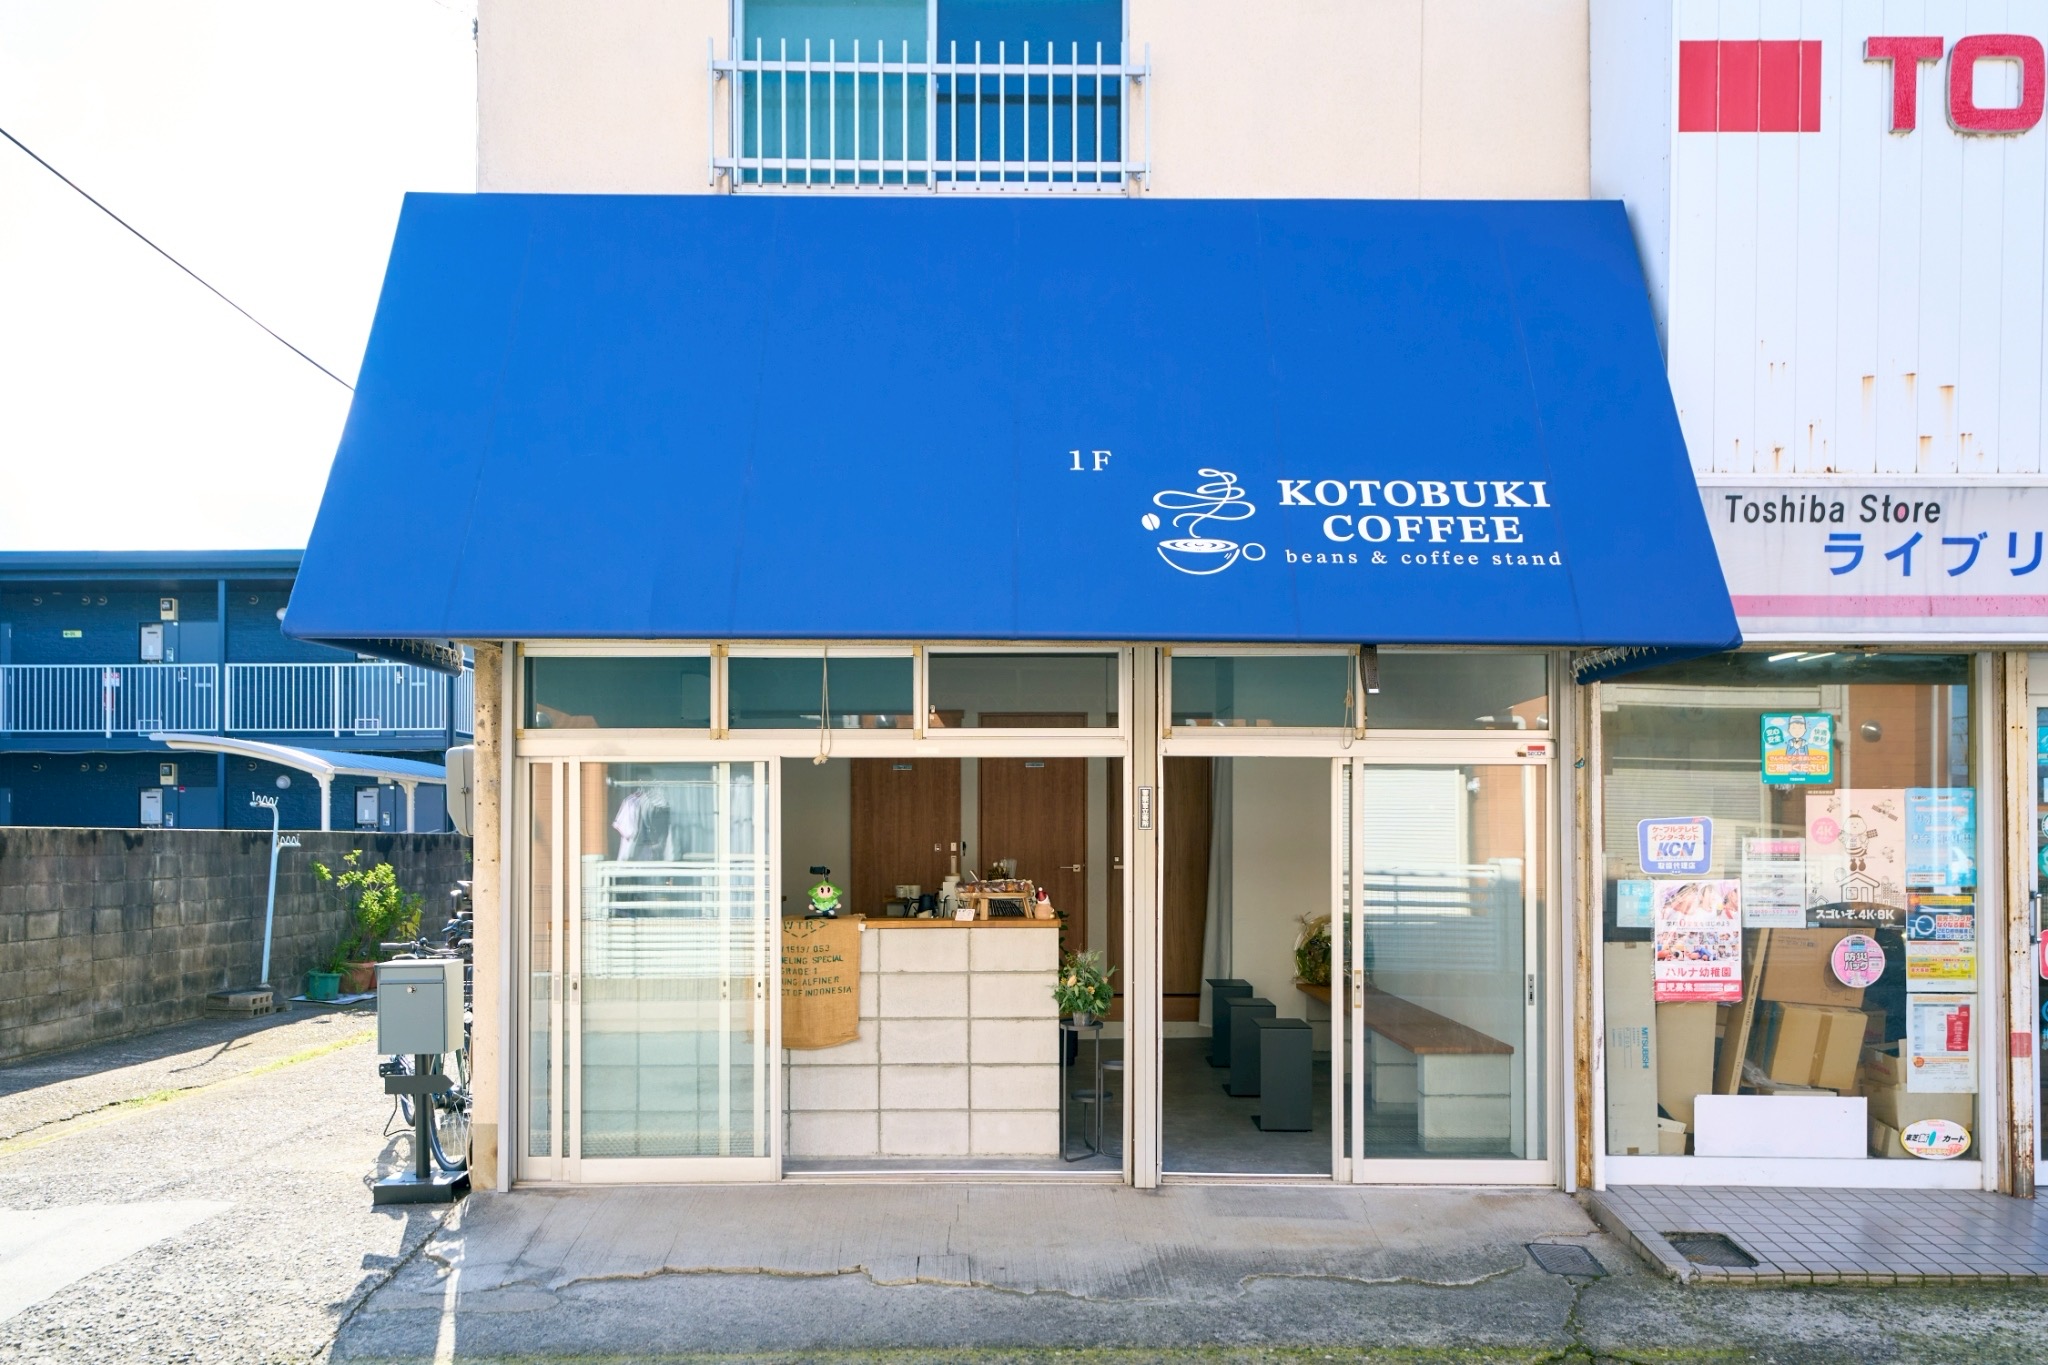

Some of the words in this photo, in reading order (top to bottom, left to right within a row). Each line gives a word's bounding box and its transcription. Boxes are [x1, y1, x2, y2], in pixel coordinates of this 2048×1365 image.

[1863, 34, 2046, 135] TO
[1069, 449, 1112, 471] 1F
[1276, 479, 1551, 508] KOTOBUKI
[1725, 494, 1845, 523] Toshiba
[1859, 494, 1941, 524] Store
[1322, 514, 1524, 544] COFFEE
[1285, 549, 1358, 564] beans
[1371, 550, 1388, 564] &
[1401, 550, 1479, 565] coffee
[1492, 551, 1562, 566] stand
[1824, 531, 2044, 577] ライブリ
[1651, 825, 1699, 833] ケーブルテレビ
[1651, 833, 1699, 841] インターネット
[1656, 841, 1696, 857] KCN
[812, 955, 844, 964] SPECIAL
[1665, 966, 1732, 978] ハルナ幼稚園
[805, 986, 852, 997] INDONESIA
[1641, 1026, 1649, 1069] MITSUBISHI
[1942, 1135, 1965, 1143] カード
